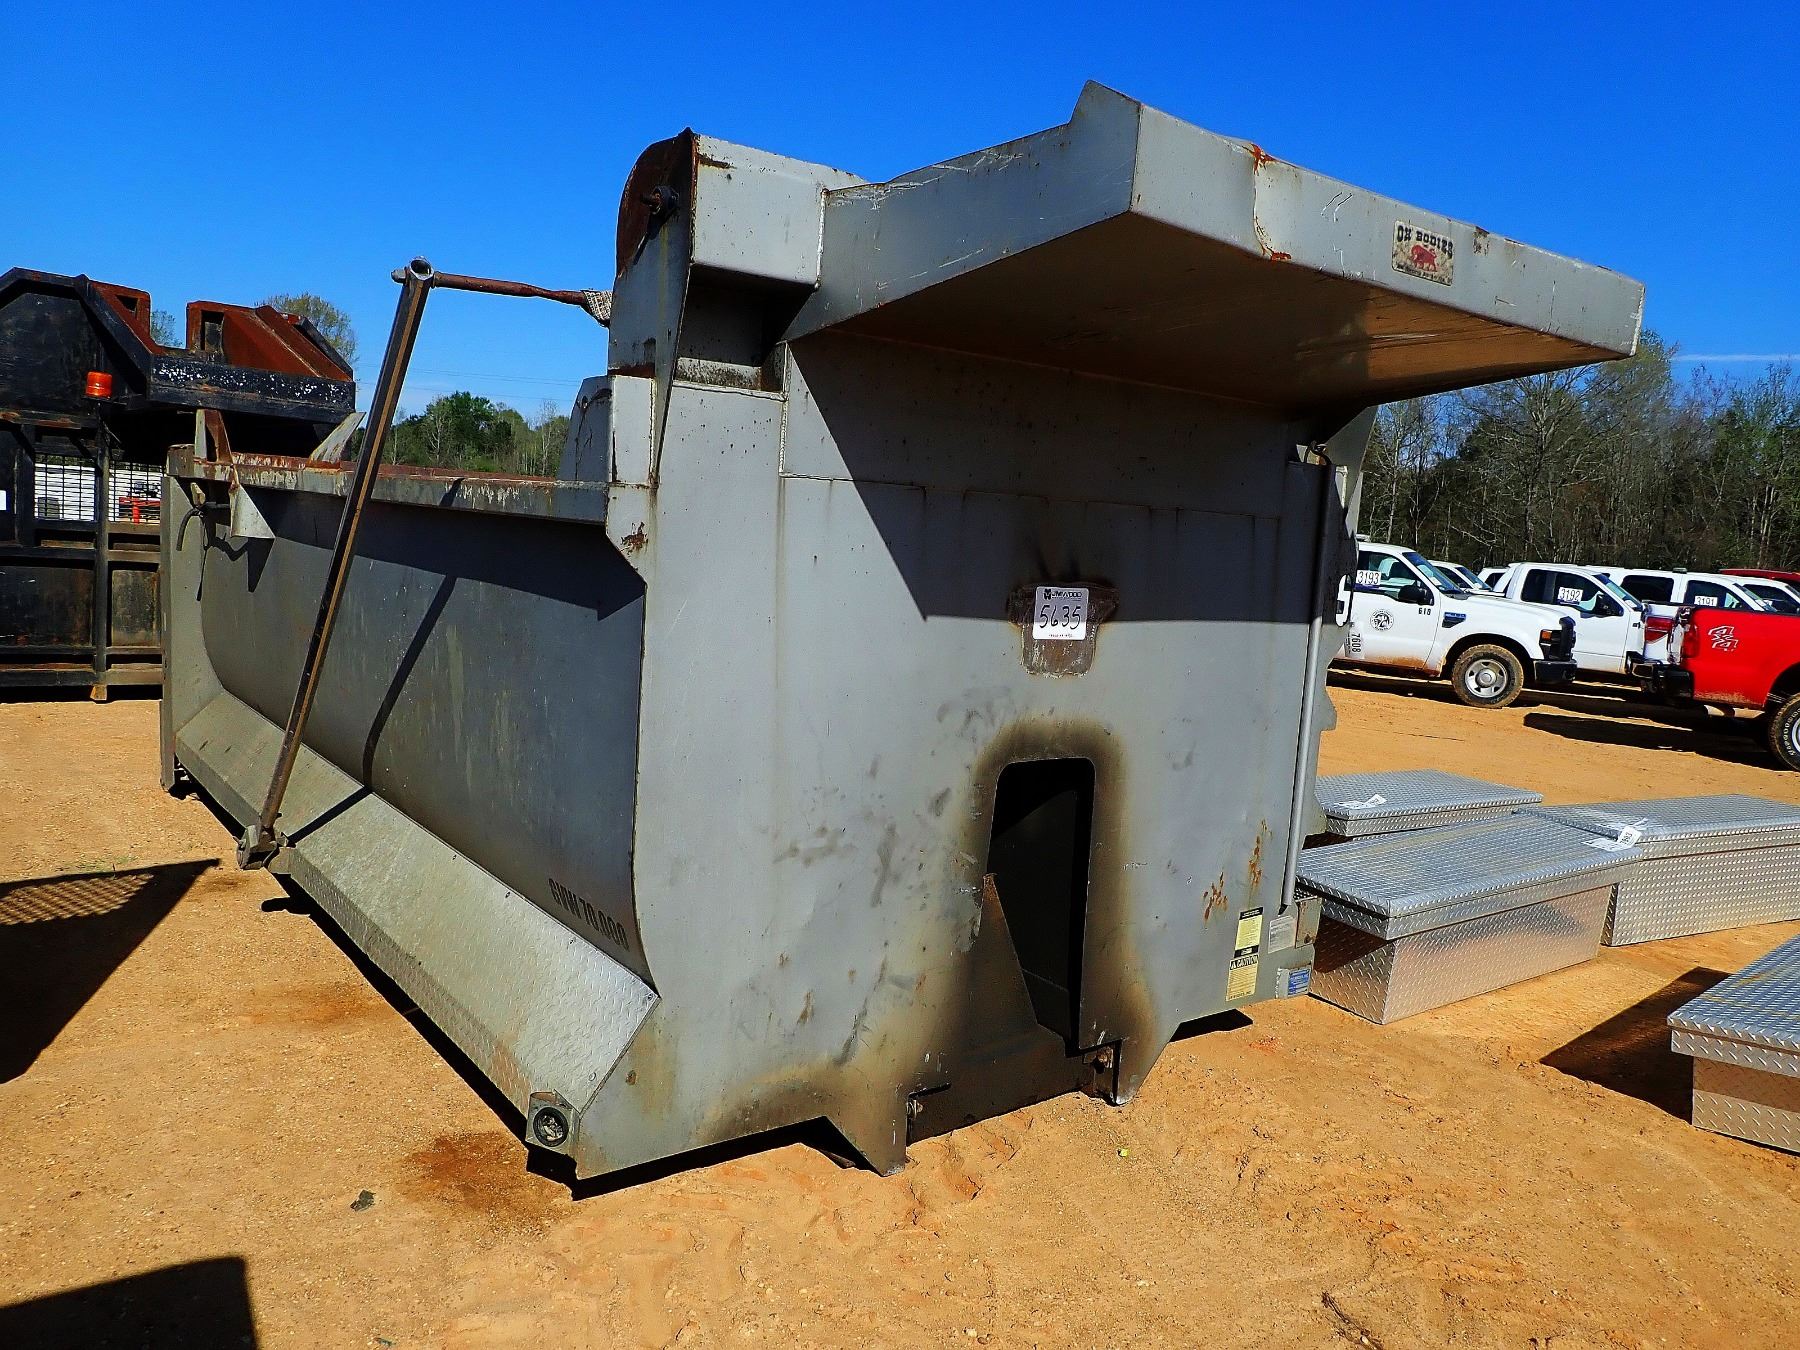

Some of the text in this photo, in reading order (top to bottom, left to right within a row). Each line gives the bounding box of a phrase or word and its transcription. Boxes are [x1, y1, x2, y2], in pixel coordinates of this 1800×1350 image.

[1397, 225, 1454, 259] OX BODIES
[1357, 571, 1380, 585] 3193
[1559, 588, 1581, 601] 3192
[1039, 604, 1082, 630] 5635
[1351, 633, 1362, 653] 7608
[548, 878, 582, 919] GVW
